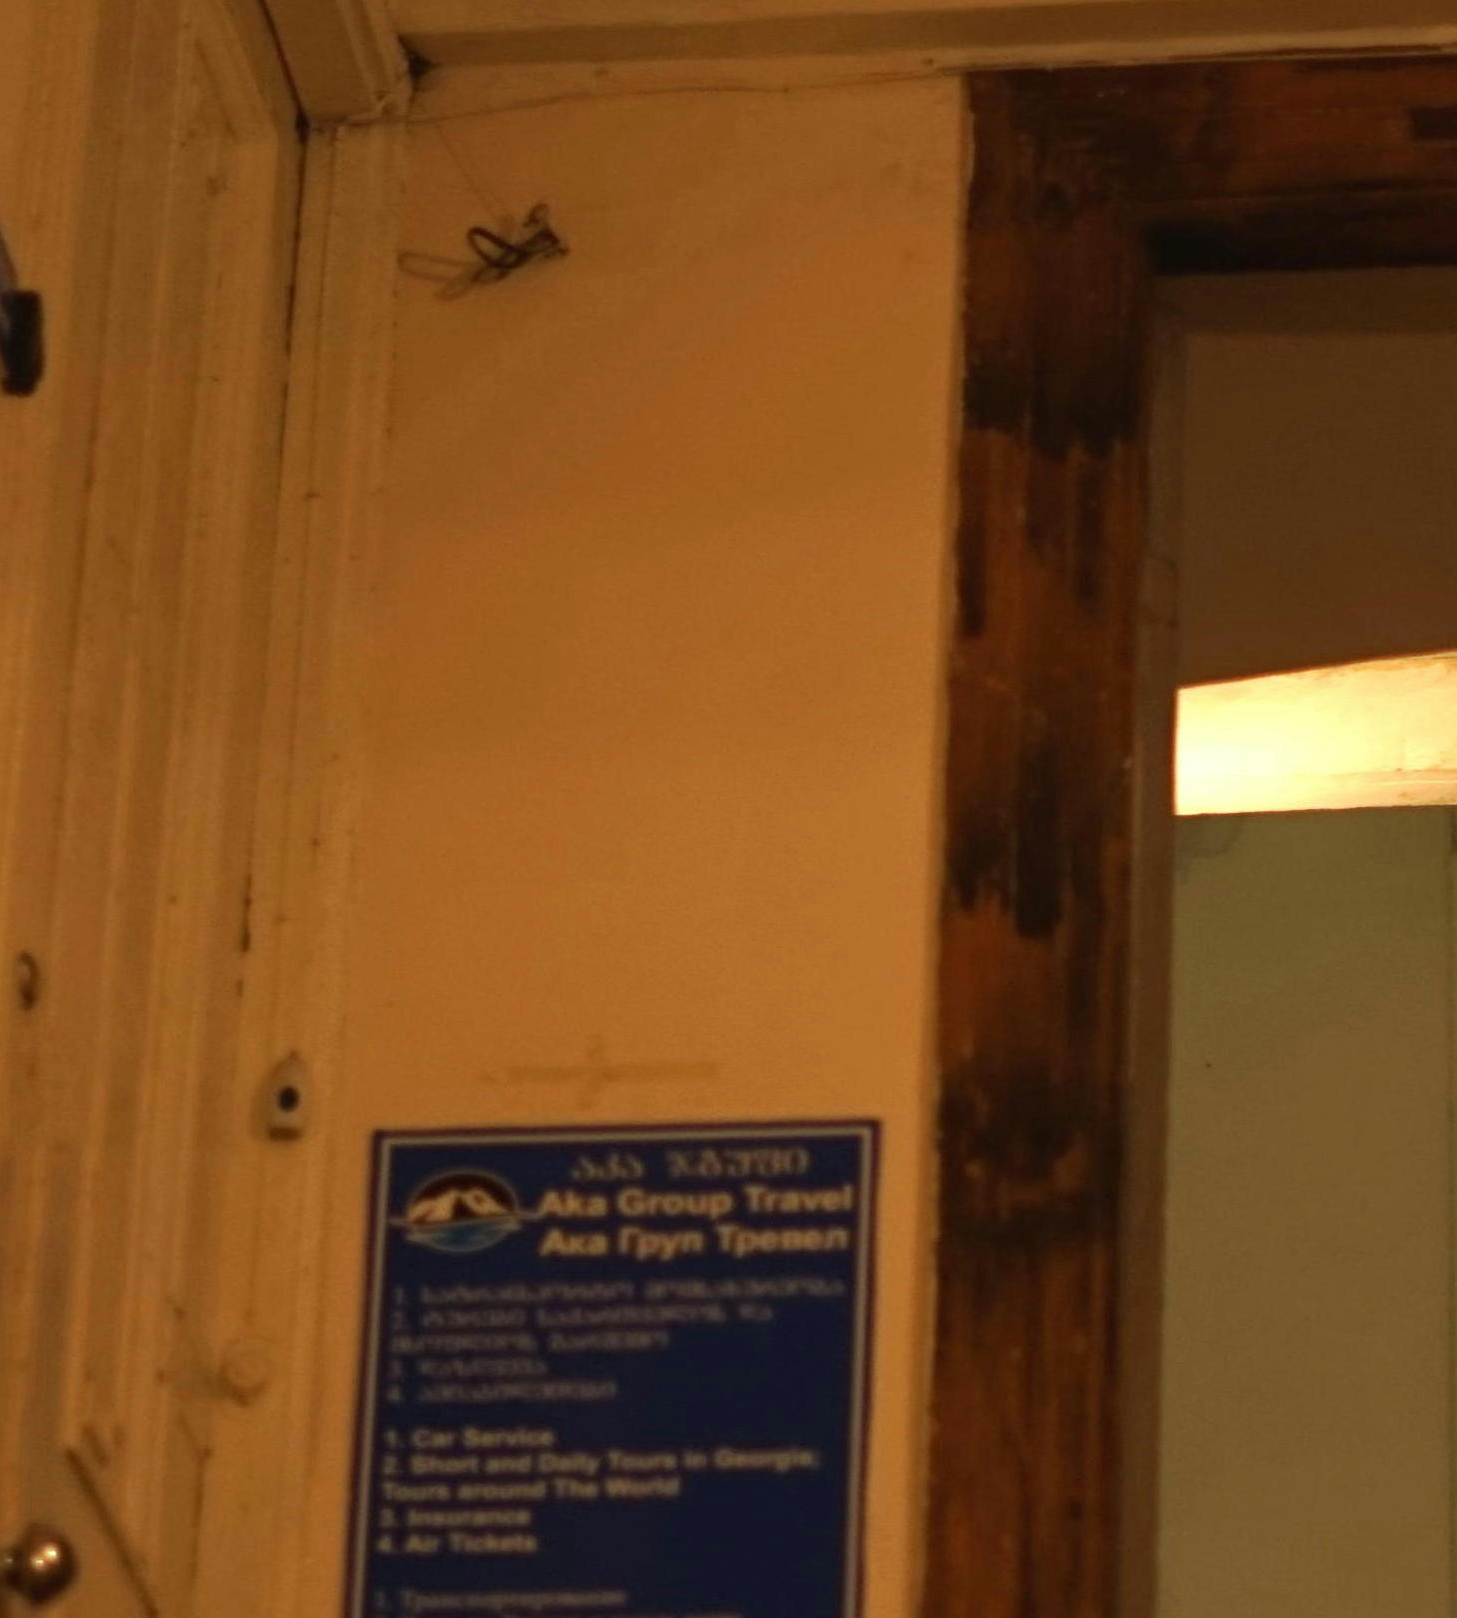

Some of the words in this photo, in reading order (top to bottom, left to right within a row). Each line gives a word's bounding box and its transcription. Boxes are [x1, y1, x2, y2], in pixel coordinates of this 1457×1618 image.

[541, 1191, 607, 1218] Aka
[618, 1187, 733, 1223] Group
[745, 1184, 853, 1214] Travel
[618, 1226, 705, 1261] Груп
[718, 1224, 849, 1259] Тревел
[383, 1429, 404, 1449] 1.
[411, 1428, 455, 1449] Car
[463, 1426, 556, 1448] Service
[382, 1457, 404, 1475] 2.
[409, 1454, 479, 1475] Short
[485, 1453, 532, 1474] and
[539, 1452, 599, 1477] Daily
[607, 1451, 678, 1472] Tours
[684, 1449, 709, 1470] in
[382, 1482, 451, 1502] Tours
[457, 1480, 547, 1500] around
[554, 1478, 600, 1499] The
[605, 1476, 681, 1498] World
[379, 1508, 400, 1528] 3.
[406, 1506, 532, 1528] Insurance
[375, 1534, 398, 1554] 4.
[404, 1534, 441, 1554] Air
[449, 1532, 539, 1554] Tickets
